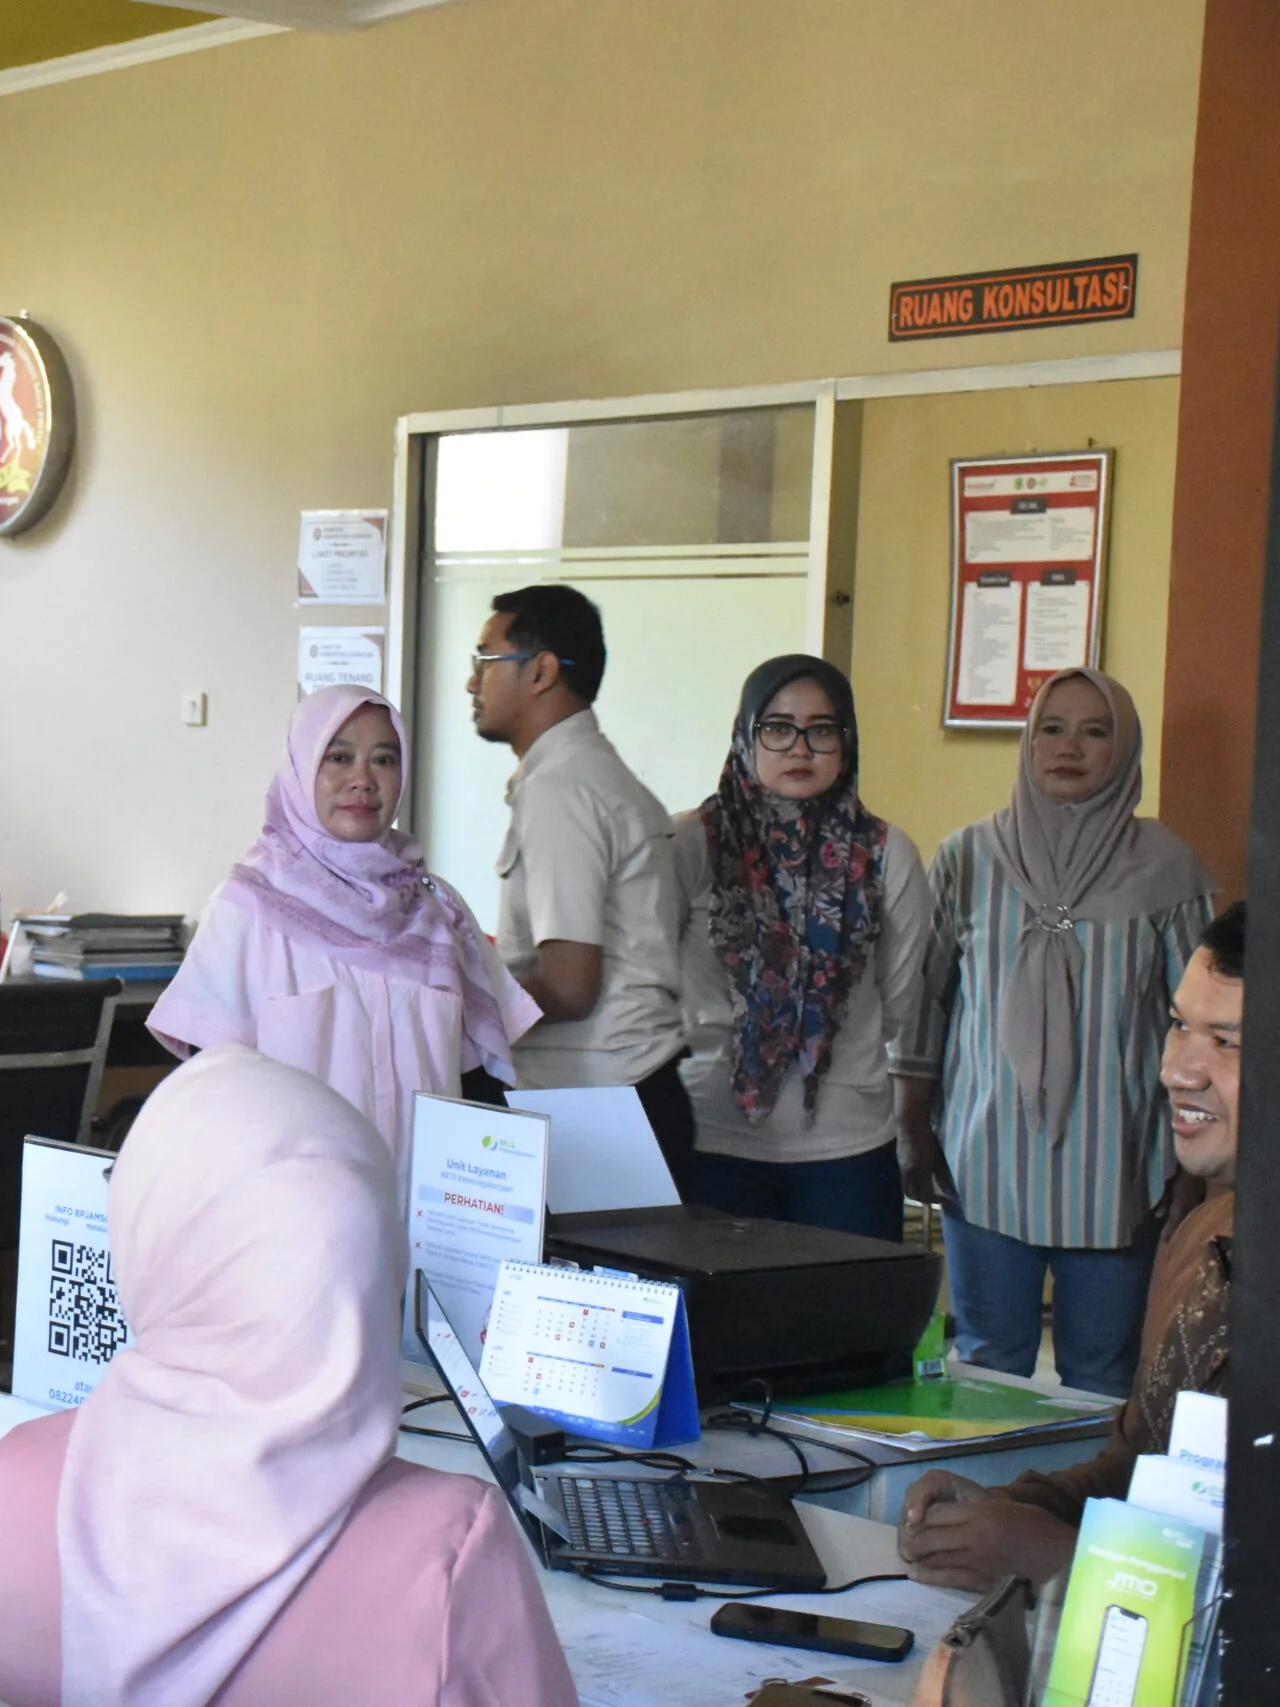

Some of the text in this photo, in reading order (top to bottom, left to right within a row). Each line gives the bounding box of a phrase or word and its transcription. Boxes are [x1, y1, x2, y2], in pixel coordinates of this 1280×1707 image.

[899, 271, 1126, 328] RUANG KONSULTASI
[304, 672, 374, 683] RUANG TENANG
[446, 1158, 507, 1181] Unit Layanan
[54, 1204, 74, 1216] INFO
[444, 1192, 504, 1215] PERHATIAN!
[1179, 1449, 1226, 1469] Progra
